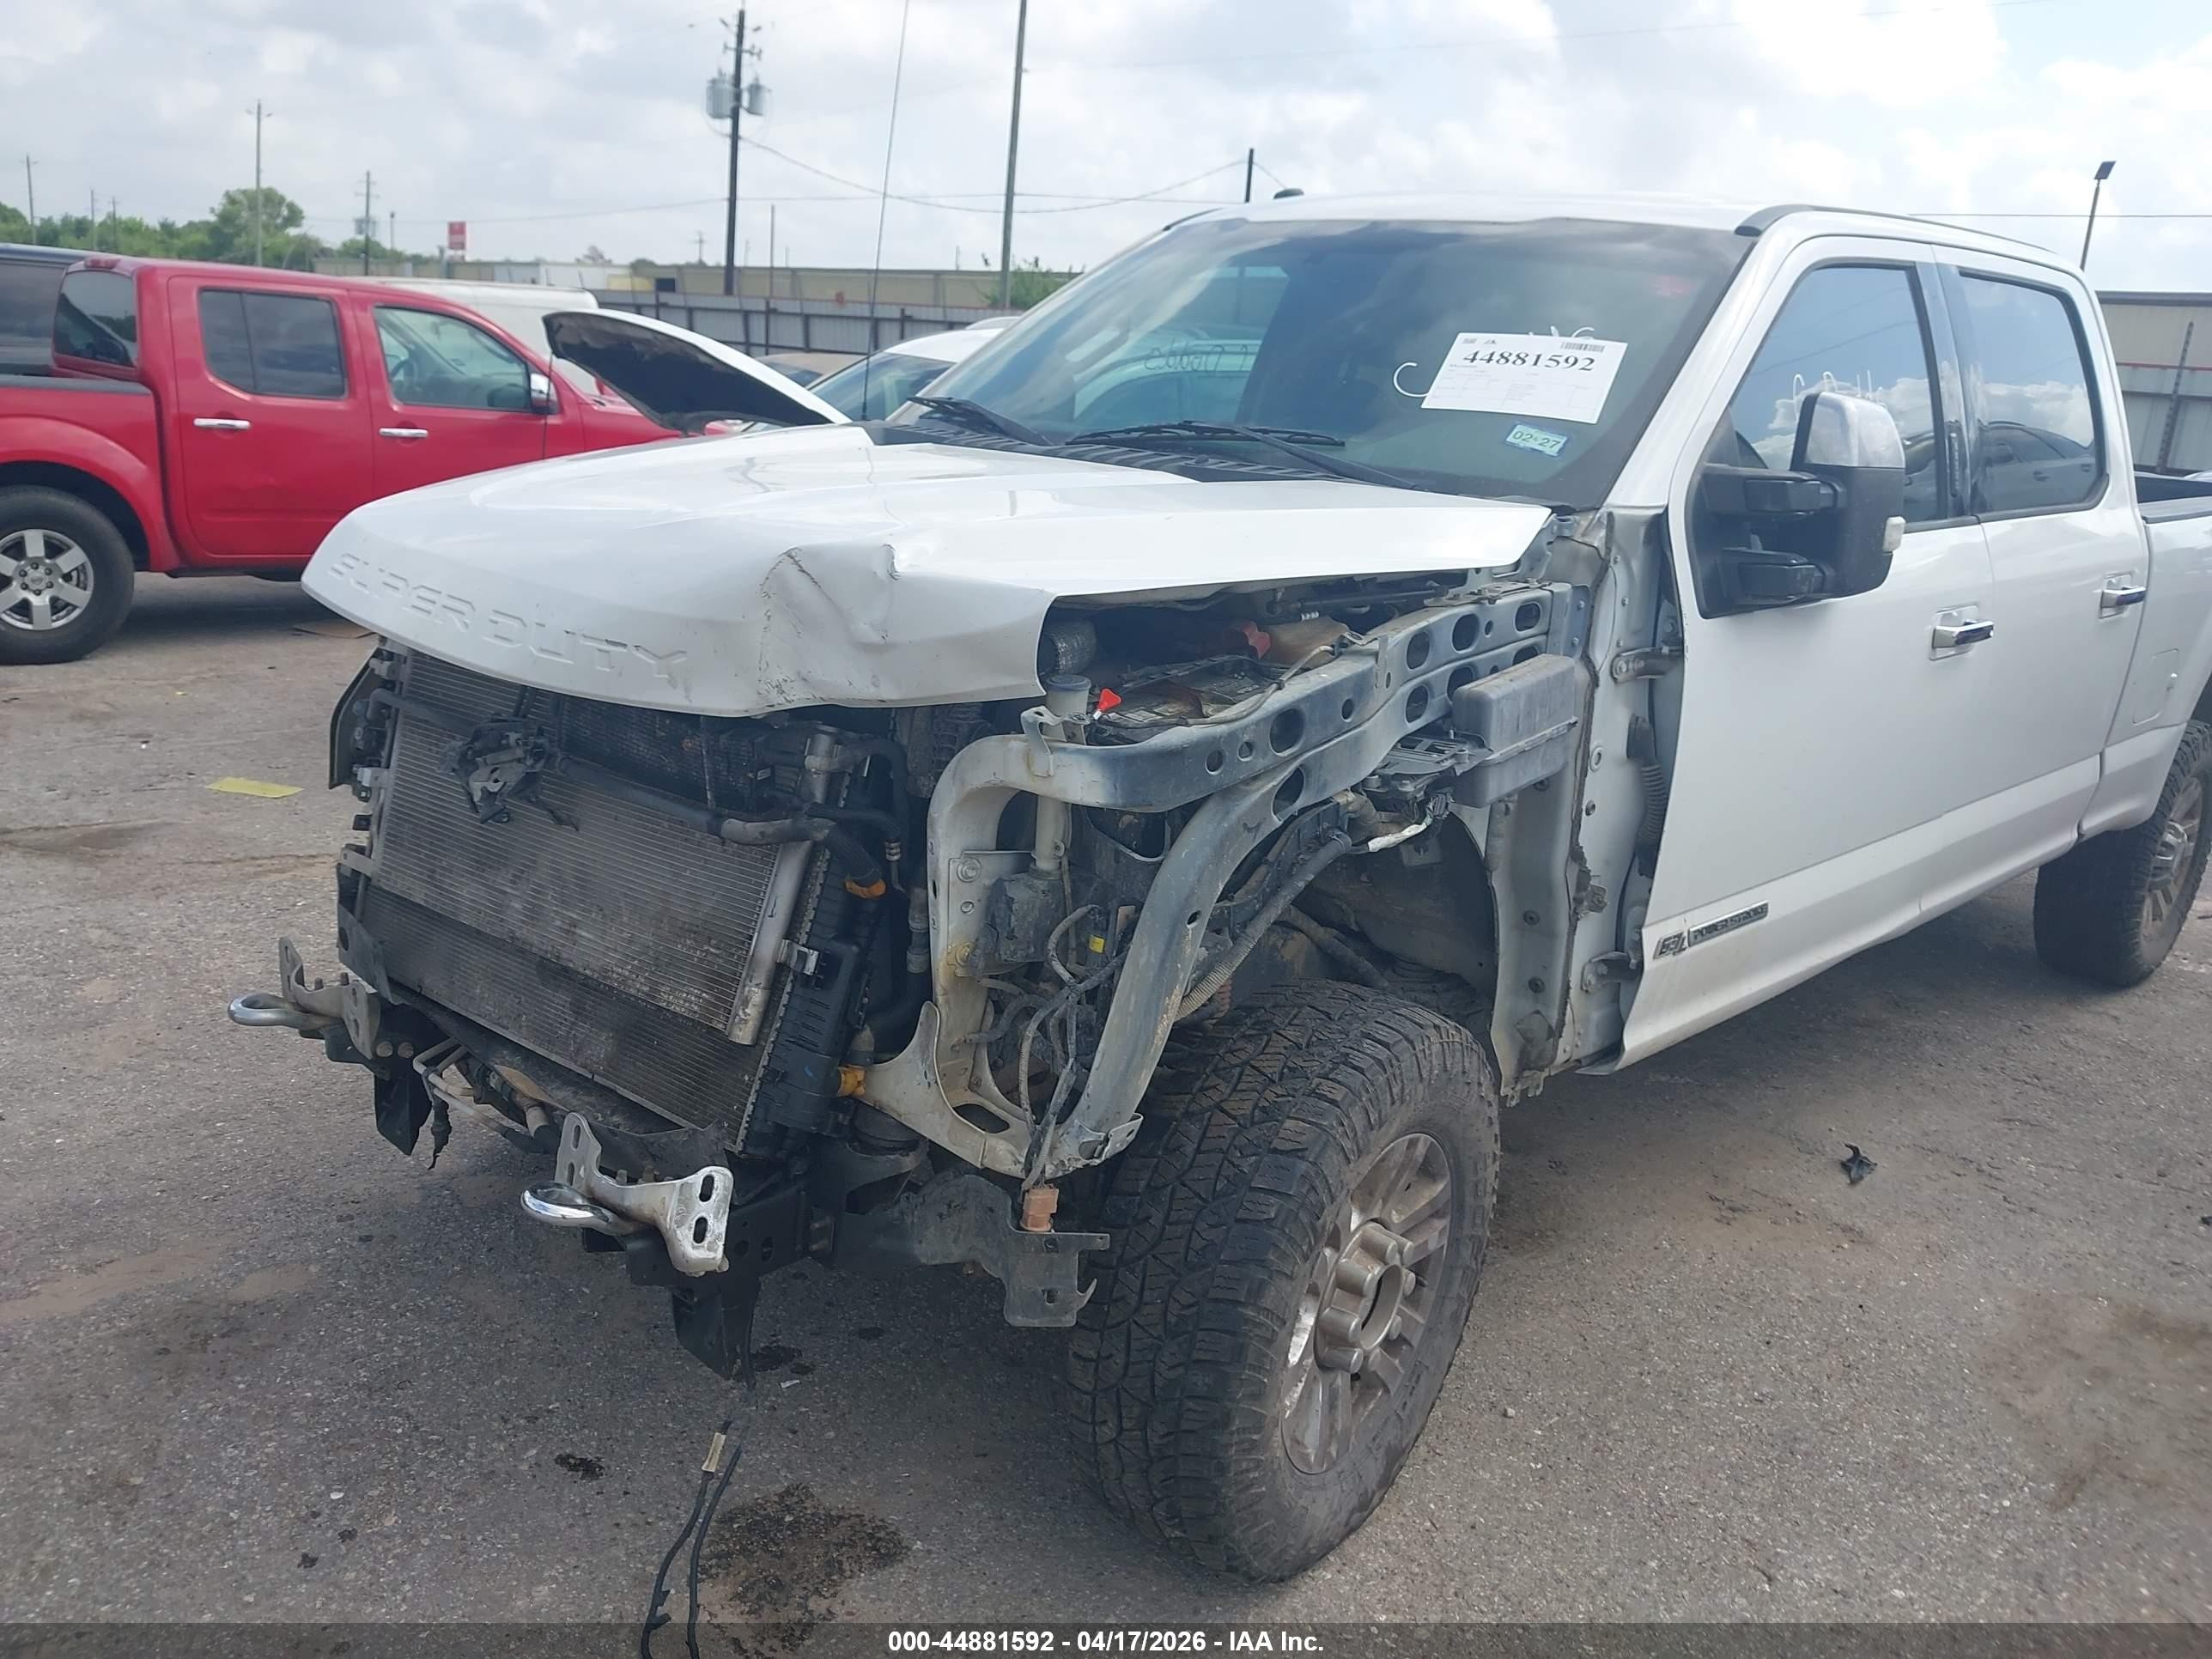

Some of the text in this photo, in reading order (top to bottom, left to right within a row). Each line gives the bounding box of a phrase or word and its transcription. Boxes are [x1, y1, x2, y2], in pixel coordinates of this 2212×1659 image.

[1463, 349, 1596, 371] 44881592
[330, 552, 687, 678] SUPER DUTY
